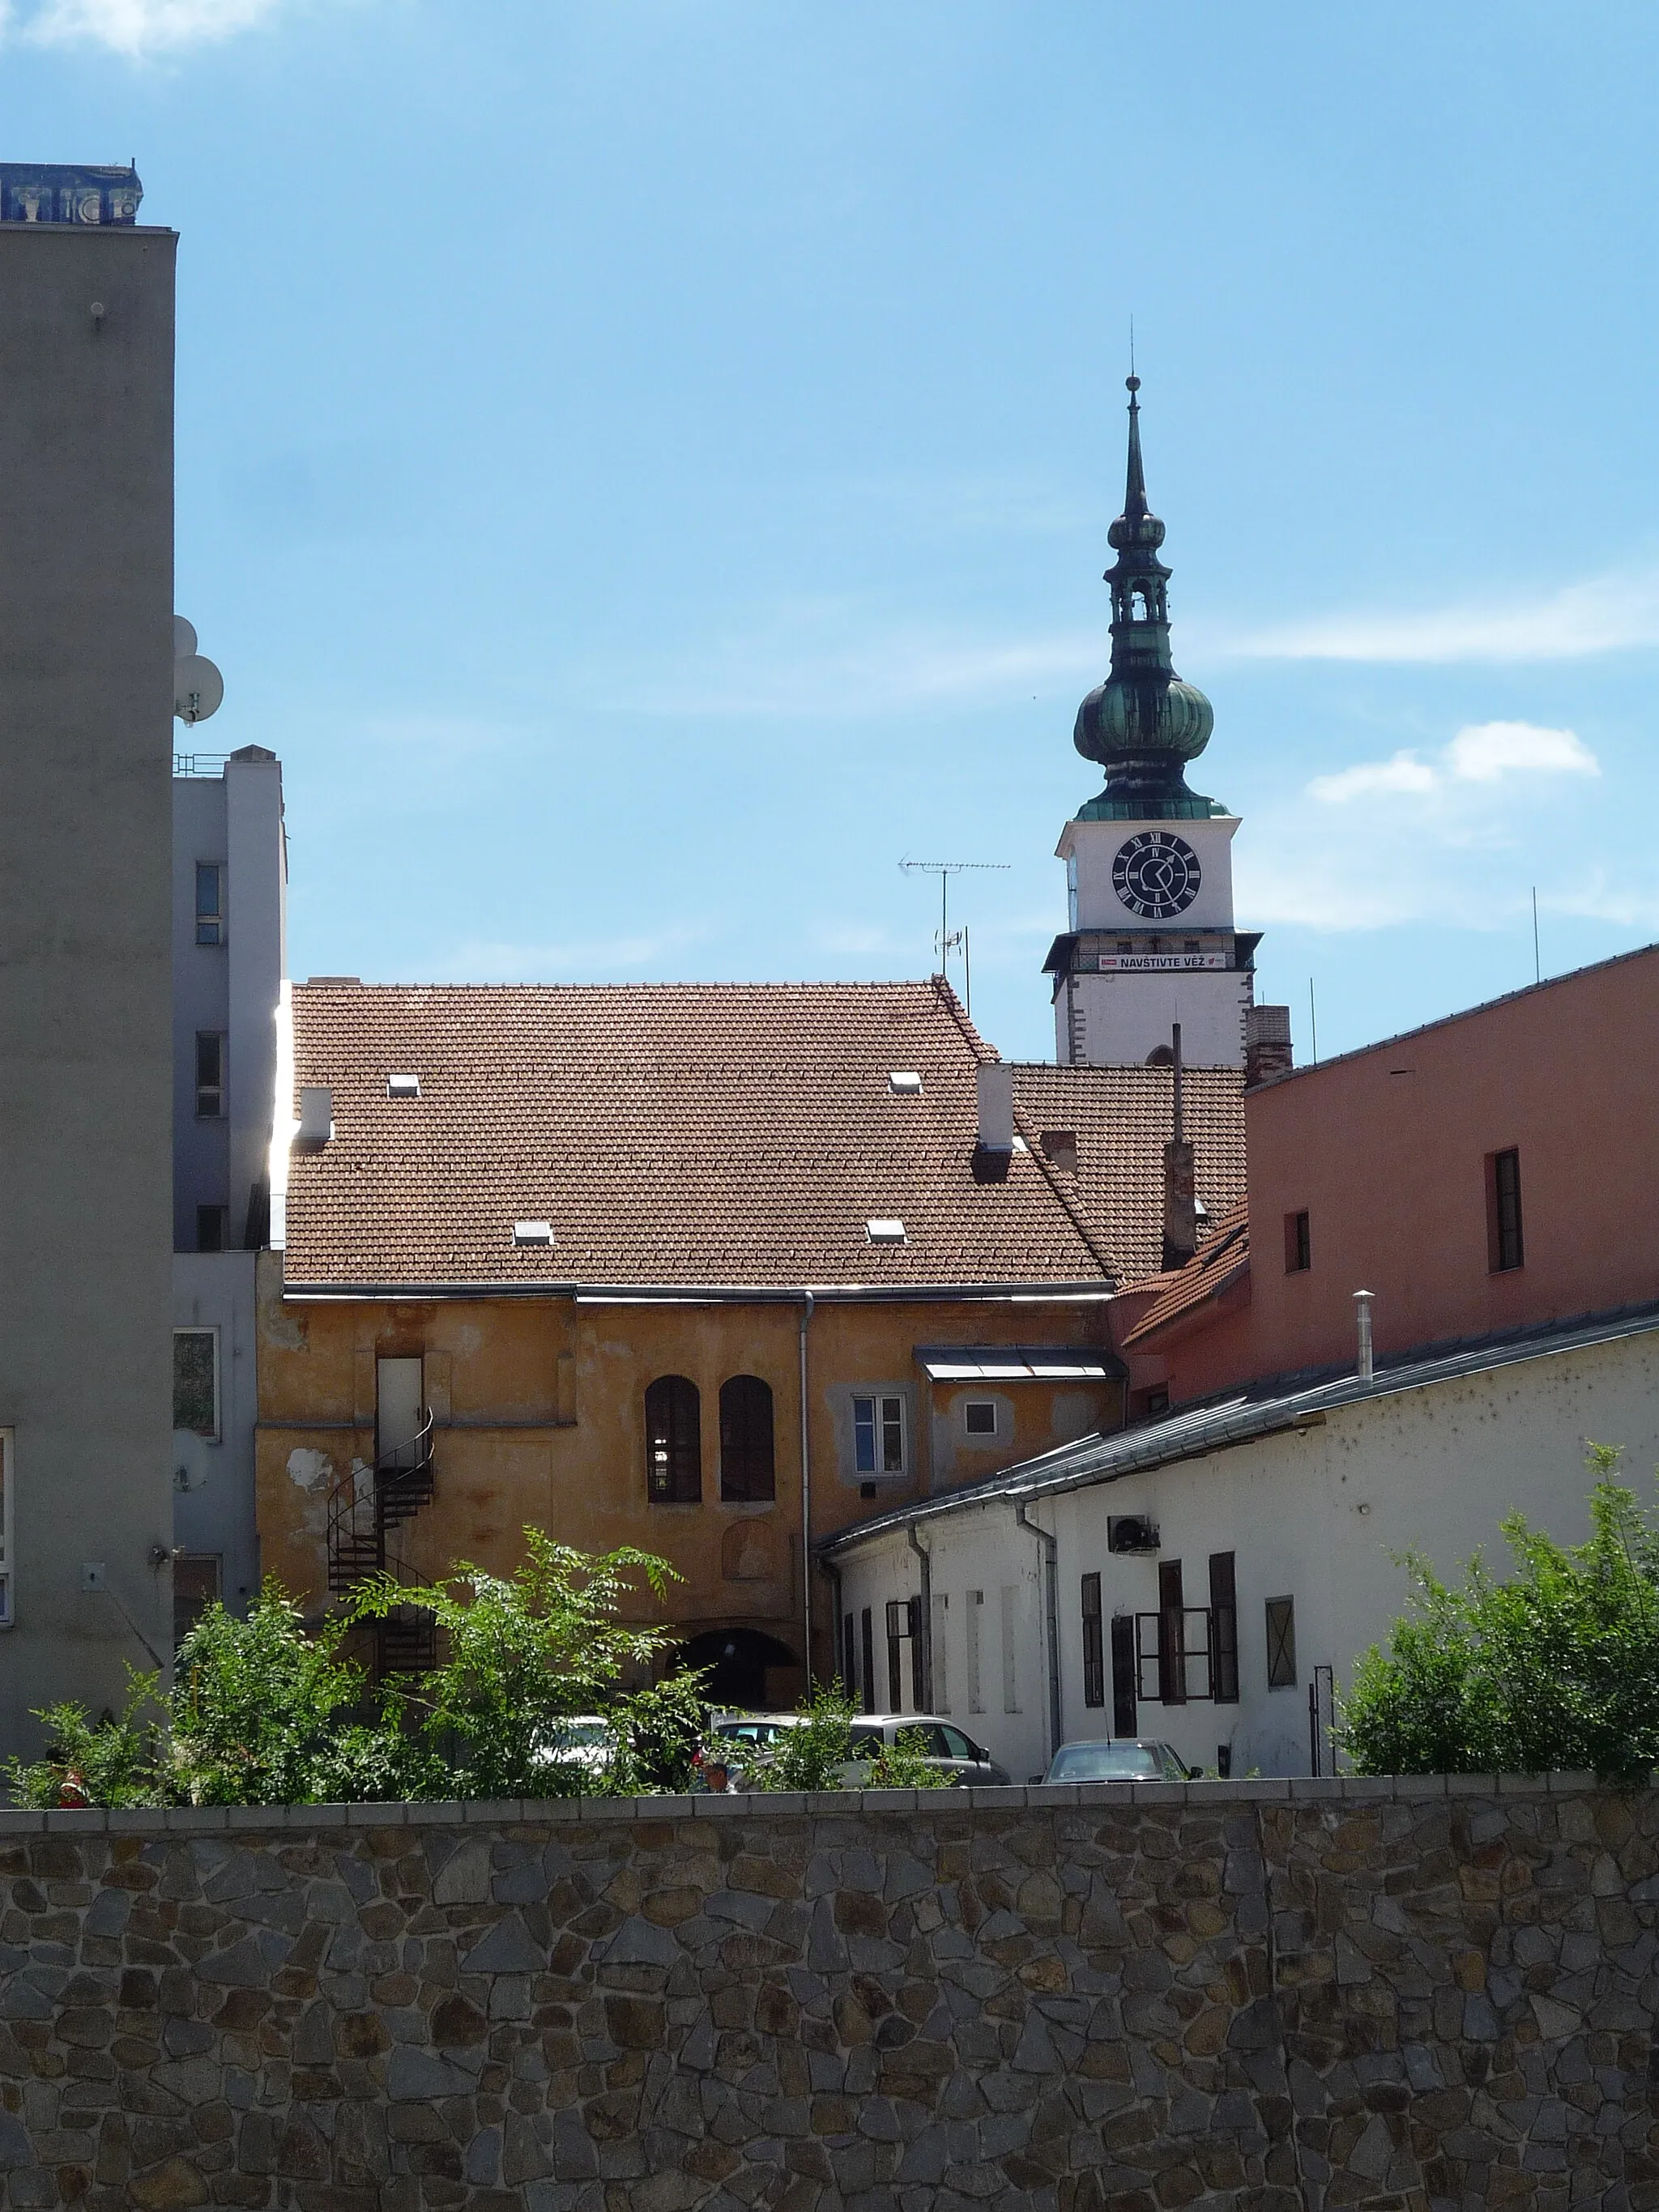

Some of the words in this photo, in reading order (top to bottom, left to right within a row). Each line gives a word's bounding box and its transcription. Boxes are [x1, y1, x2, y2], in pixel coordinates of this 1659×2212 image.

[1132, 837, 1143, 849] XI
[1150, 833, 1161, 843] XII
[1171, 837, 1178, 847] I
[1118, 852, 1129, 862] X
[1183, 851, 1194, 860] II
[1114, 872, 1124, 880] IX
[1189, 870, 1201, 878] III
[1120, 956, 1180, 967] NAVŠTIVTE
[1183, 955, 1205, 966] VĚŽ
